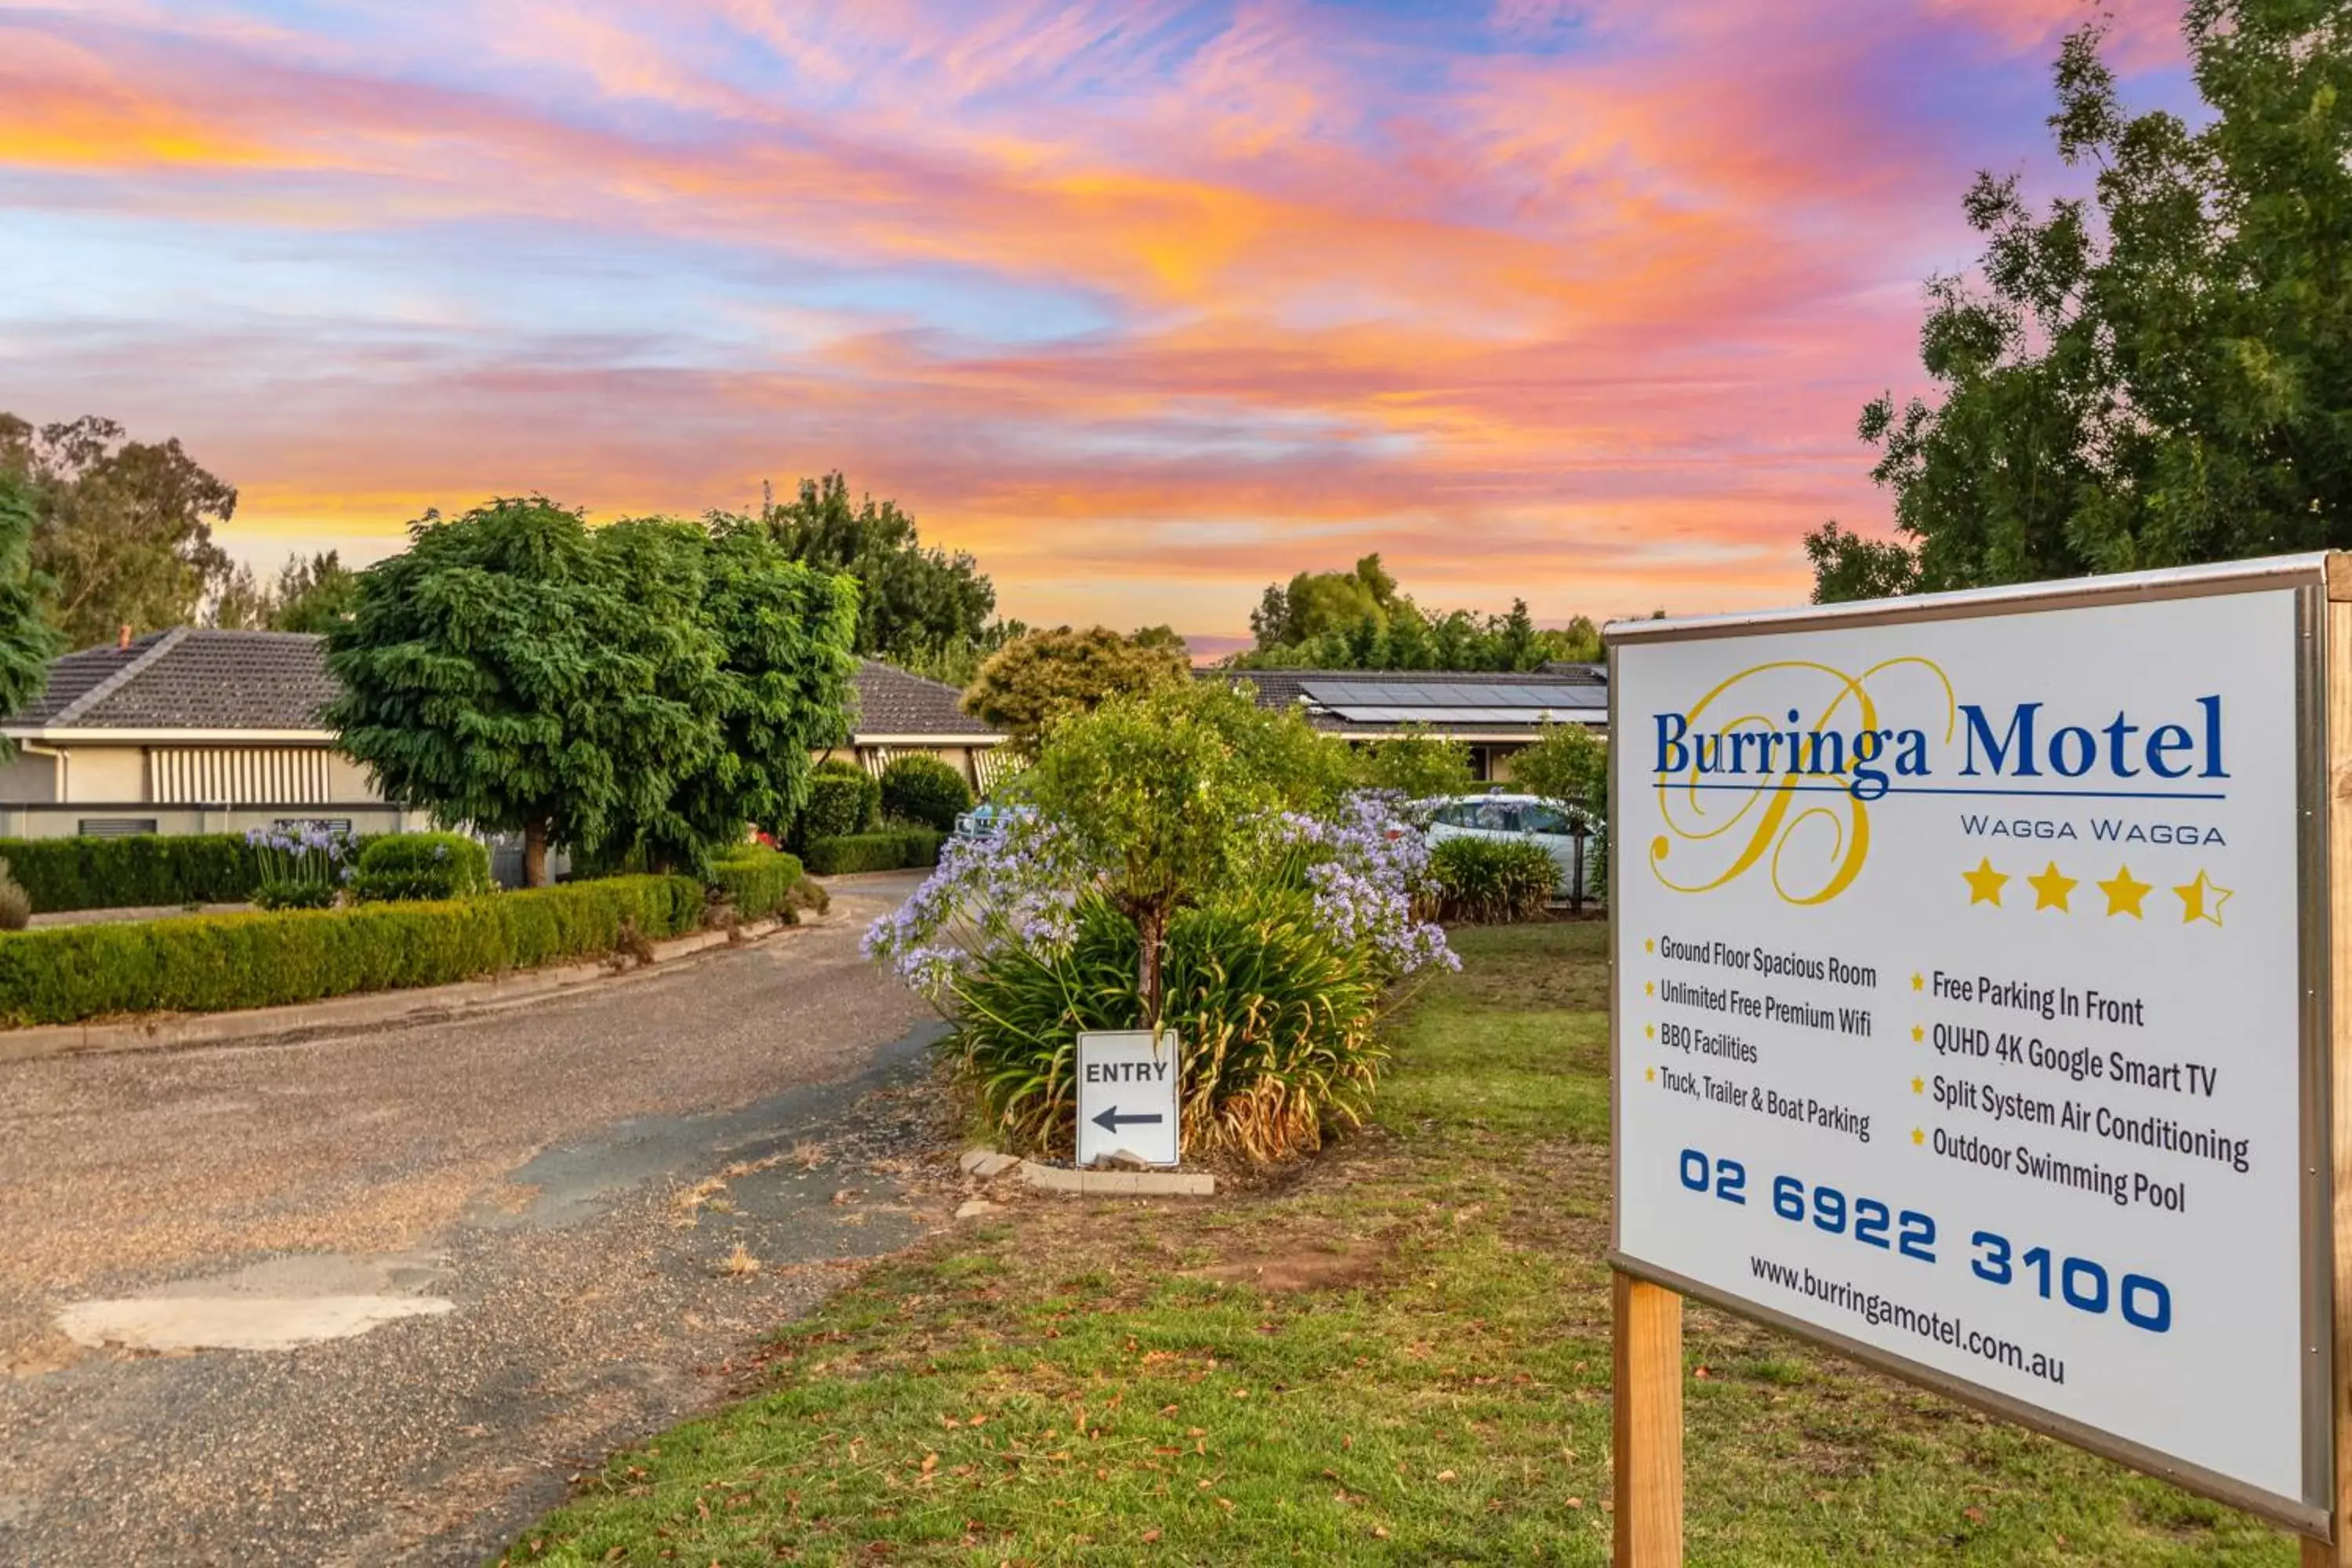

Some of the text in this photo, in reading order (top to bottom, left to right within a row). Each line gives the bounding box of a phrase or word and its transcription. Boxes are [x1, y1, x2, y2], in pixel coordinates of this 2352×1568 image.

[1653, 695, 2230, 800] Burringa Motel
[1661, 935, 1876, 988] Ground Floor Spacious Room
[1933, 971, 2144, 1026] Free Parking In Front
[1661, 978, 1871, 1036] Unlimited Free Premium Wifi
[1661, 1023, 1757, 1064] BBQ Facilities
[1087, 1062, 1167, 1082] ENTRY
[1933, 1024, 2216, 1097] QUHD 4K Google Smart TV
[1661, 1066, 1870, 1143] Truck, Trailer & Boat Parking
[1933, 1076, 2249, 1172] Split System Air Conditioning
[1933, 1128, 2184, 1212] Outdoor Swimming Pool
[1680, 1149, 2171, 1333] 02 6922 3100
[1751, 1255, 2065, 1385] www.burringamotel.com.au
